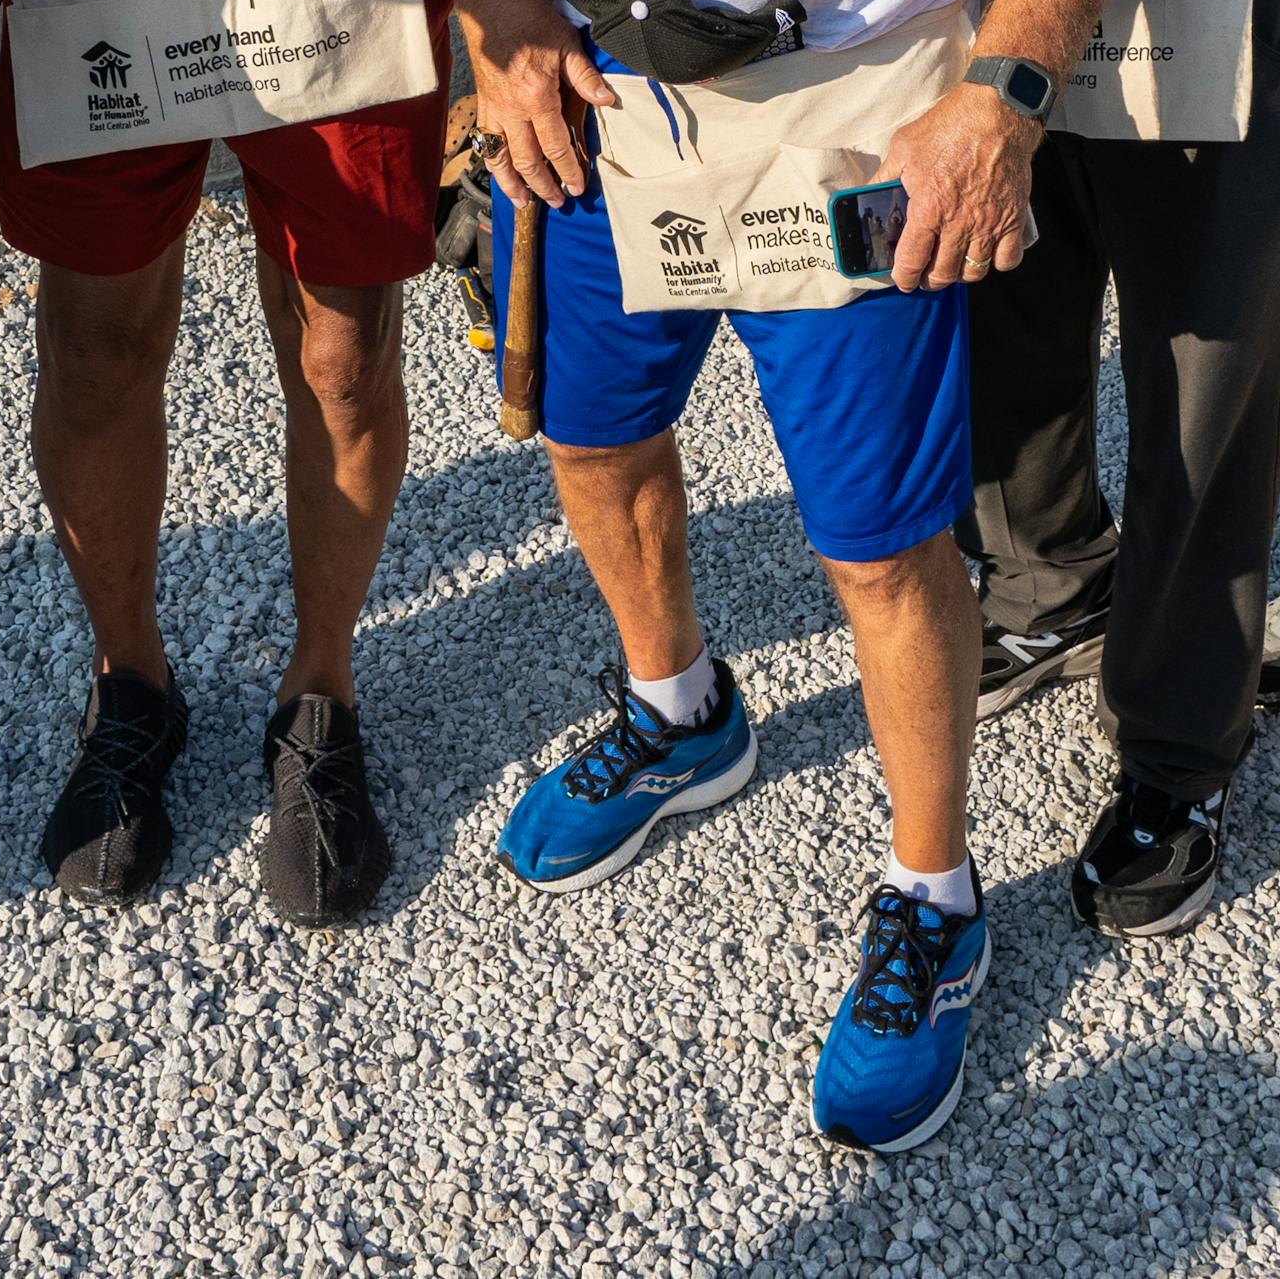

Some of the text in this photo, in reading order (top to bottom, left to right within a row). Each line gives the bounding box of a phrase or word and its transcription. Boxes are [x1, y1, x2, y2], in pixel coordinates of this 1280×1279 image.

[165, 24, 276, 60] every hand
[168, 30, 351, 82] makes a difference
[174, 76, 280, 105] habitateco.org
[88, 92, 141, 111] Habitat
[89, 110, 102, 121] for
[90, 118, 150, 132] East Central Ohio
[740, 205, 800, 227] every
[747, 226, 810, 250] makes
[812, 232, 823, 248] a
[661, 258, 720, 277] Habitat
[666, 278, 678, 287] for
[668, 286, 728, 296] East Central Ohio
